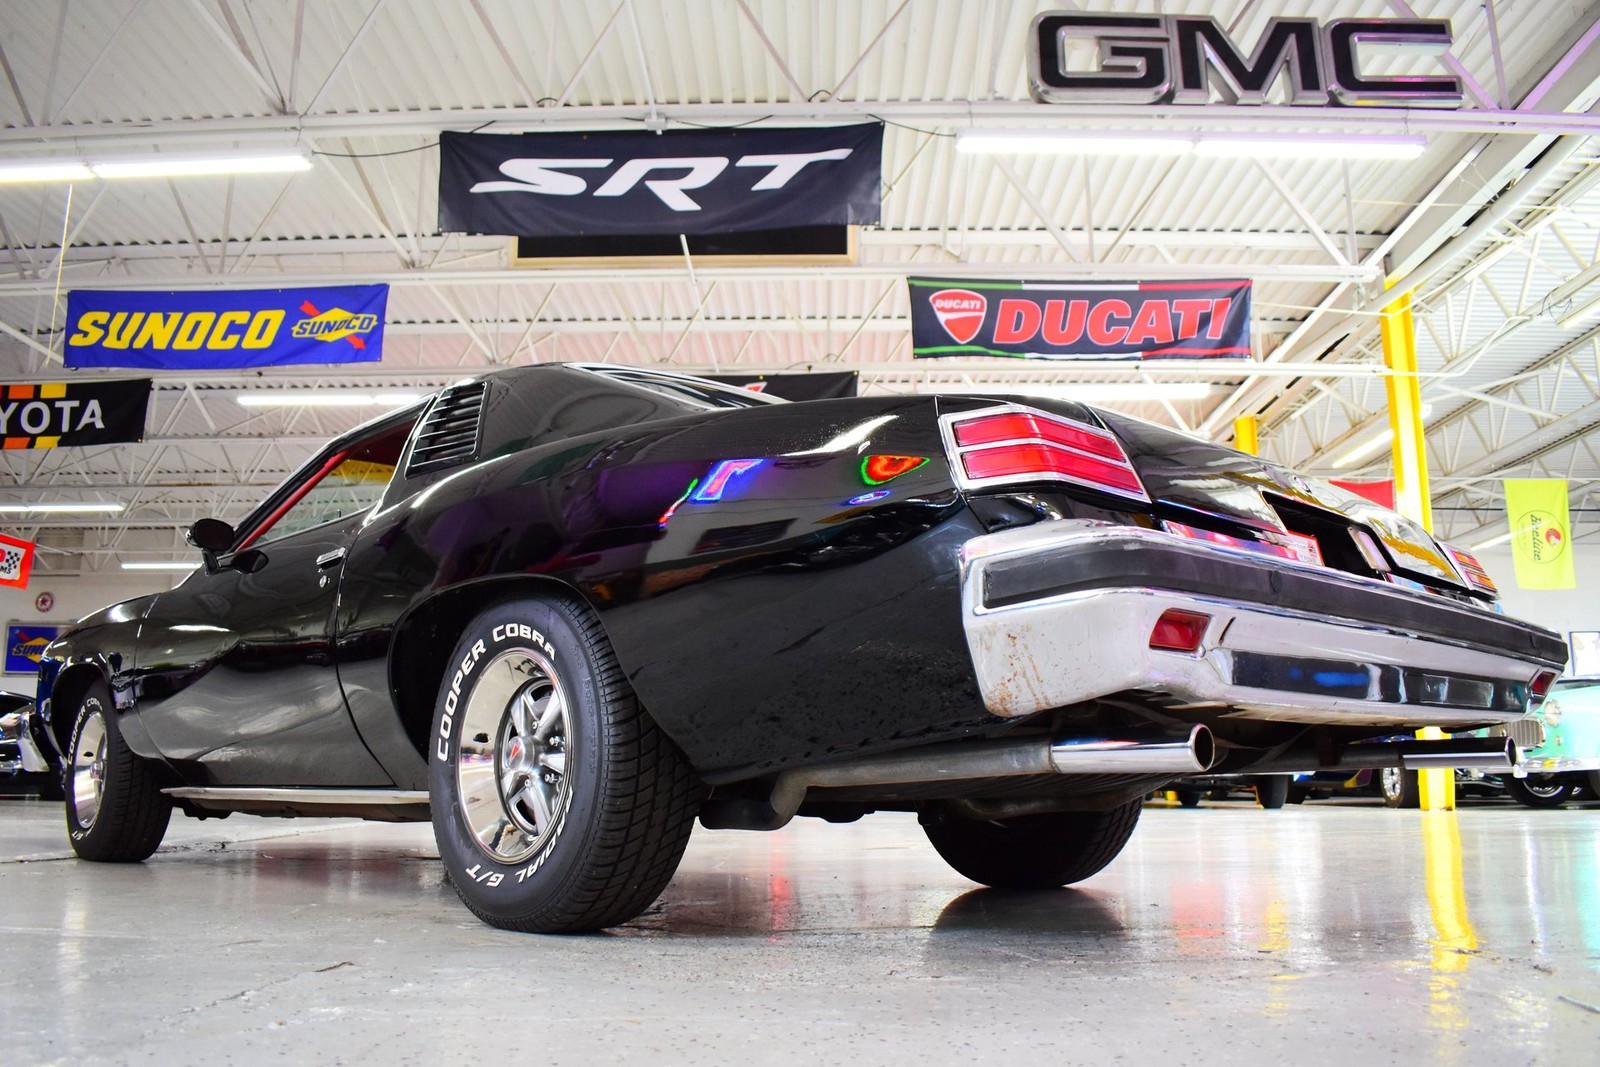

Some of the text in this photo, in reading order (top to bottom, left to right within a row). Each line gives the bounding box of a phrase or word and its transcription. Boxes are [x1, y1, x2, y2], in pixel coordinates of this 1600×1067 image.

[1029, 11, 1464, 108] GMC
[469, 148, 853, 212] SRT
[295, 316, 374, 336] SUNOCO
[935, 299, 981, 310] DUCATI
[992, 297, 1232, 346] DUCATI
[68, 309, 286, 350] SUNOCO
[437, 639, 487, 762] COOPER
[492, 623, 556, 661] COBRA
[465, 864, 505, 888] G/T
